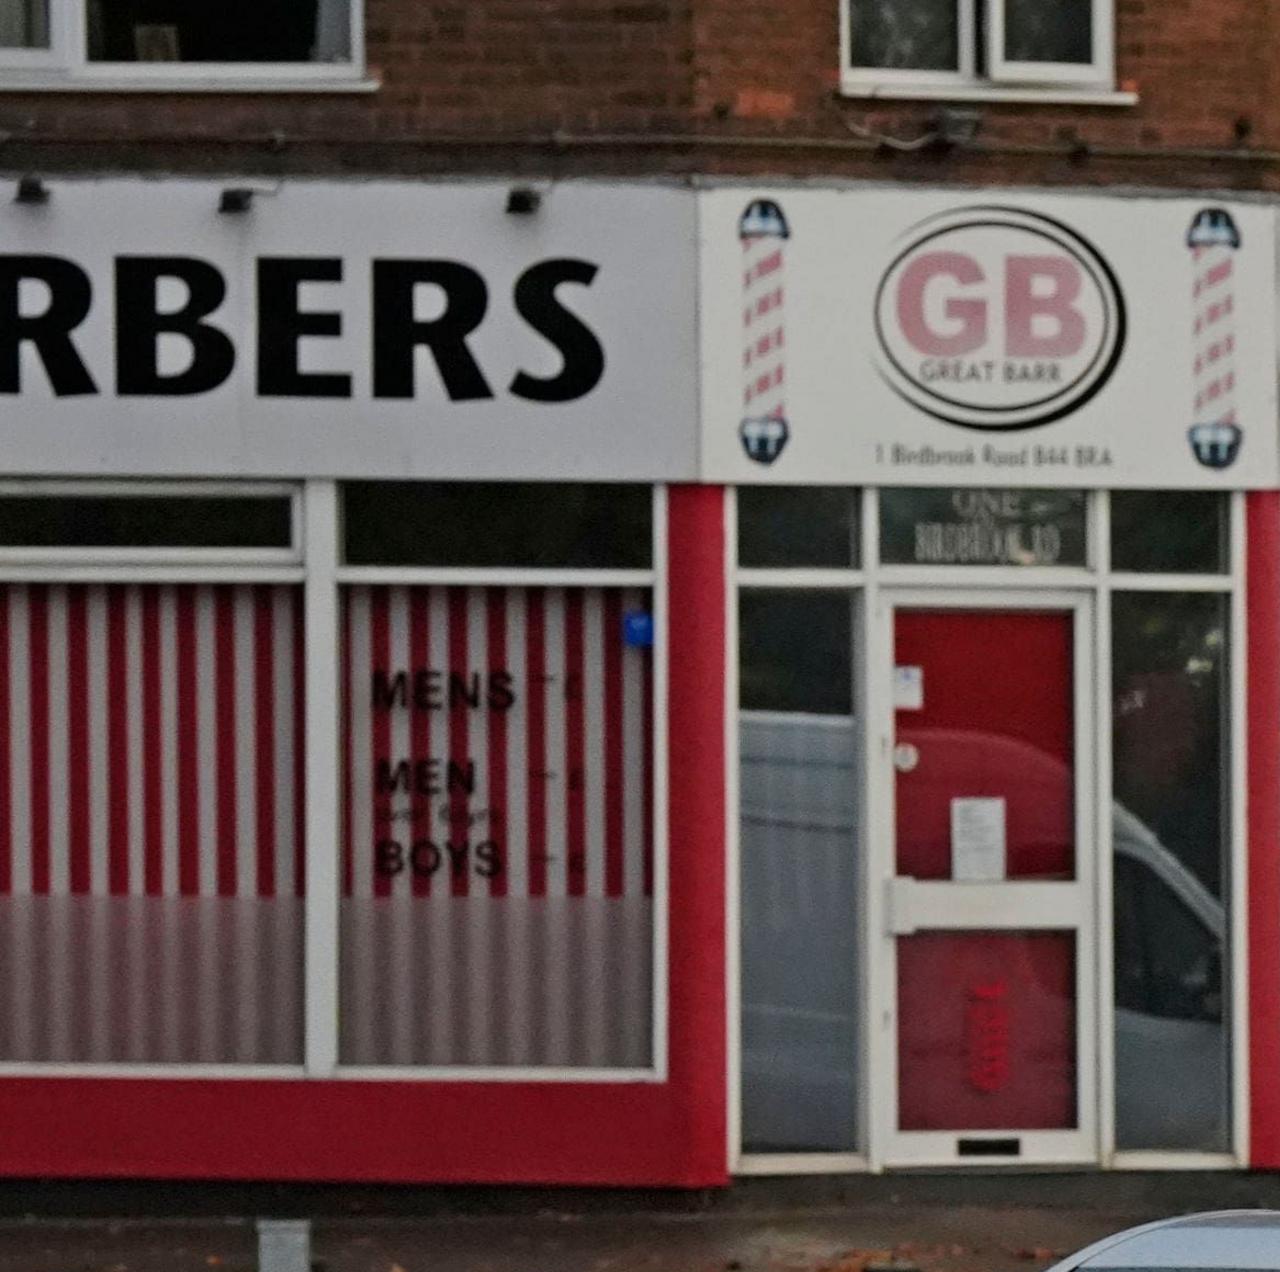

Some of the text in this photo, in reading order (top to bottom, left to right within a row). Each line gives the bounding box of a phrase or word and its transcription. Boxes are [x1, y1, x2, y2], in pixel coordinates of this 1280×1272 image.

[895, 251, 1087, 357] GB
[0, 254, 604, 403] RBERS
[918, 360, 1061, 383] GREAT BARR
[371, 670, 514, 712] MENS
[374, 758, 475, 796] MEN
[374, 839, 502, 878] BOYS
